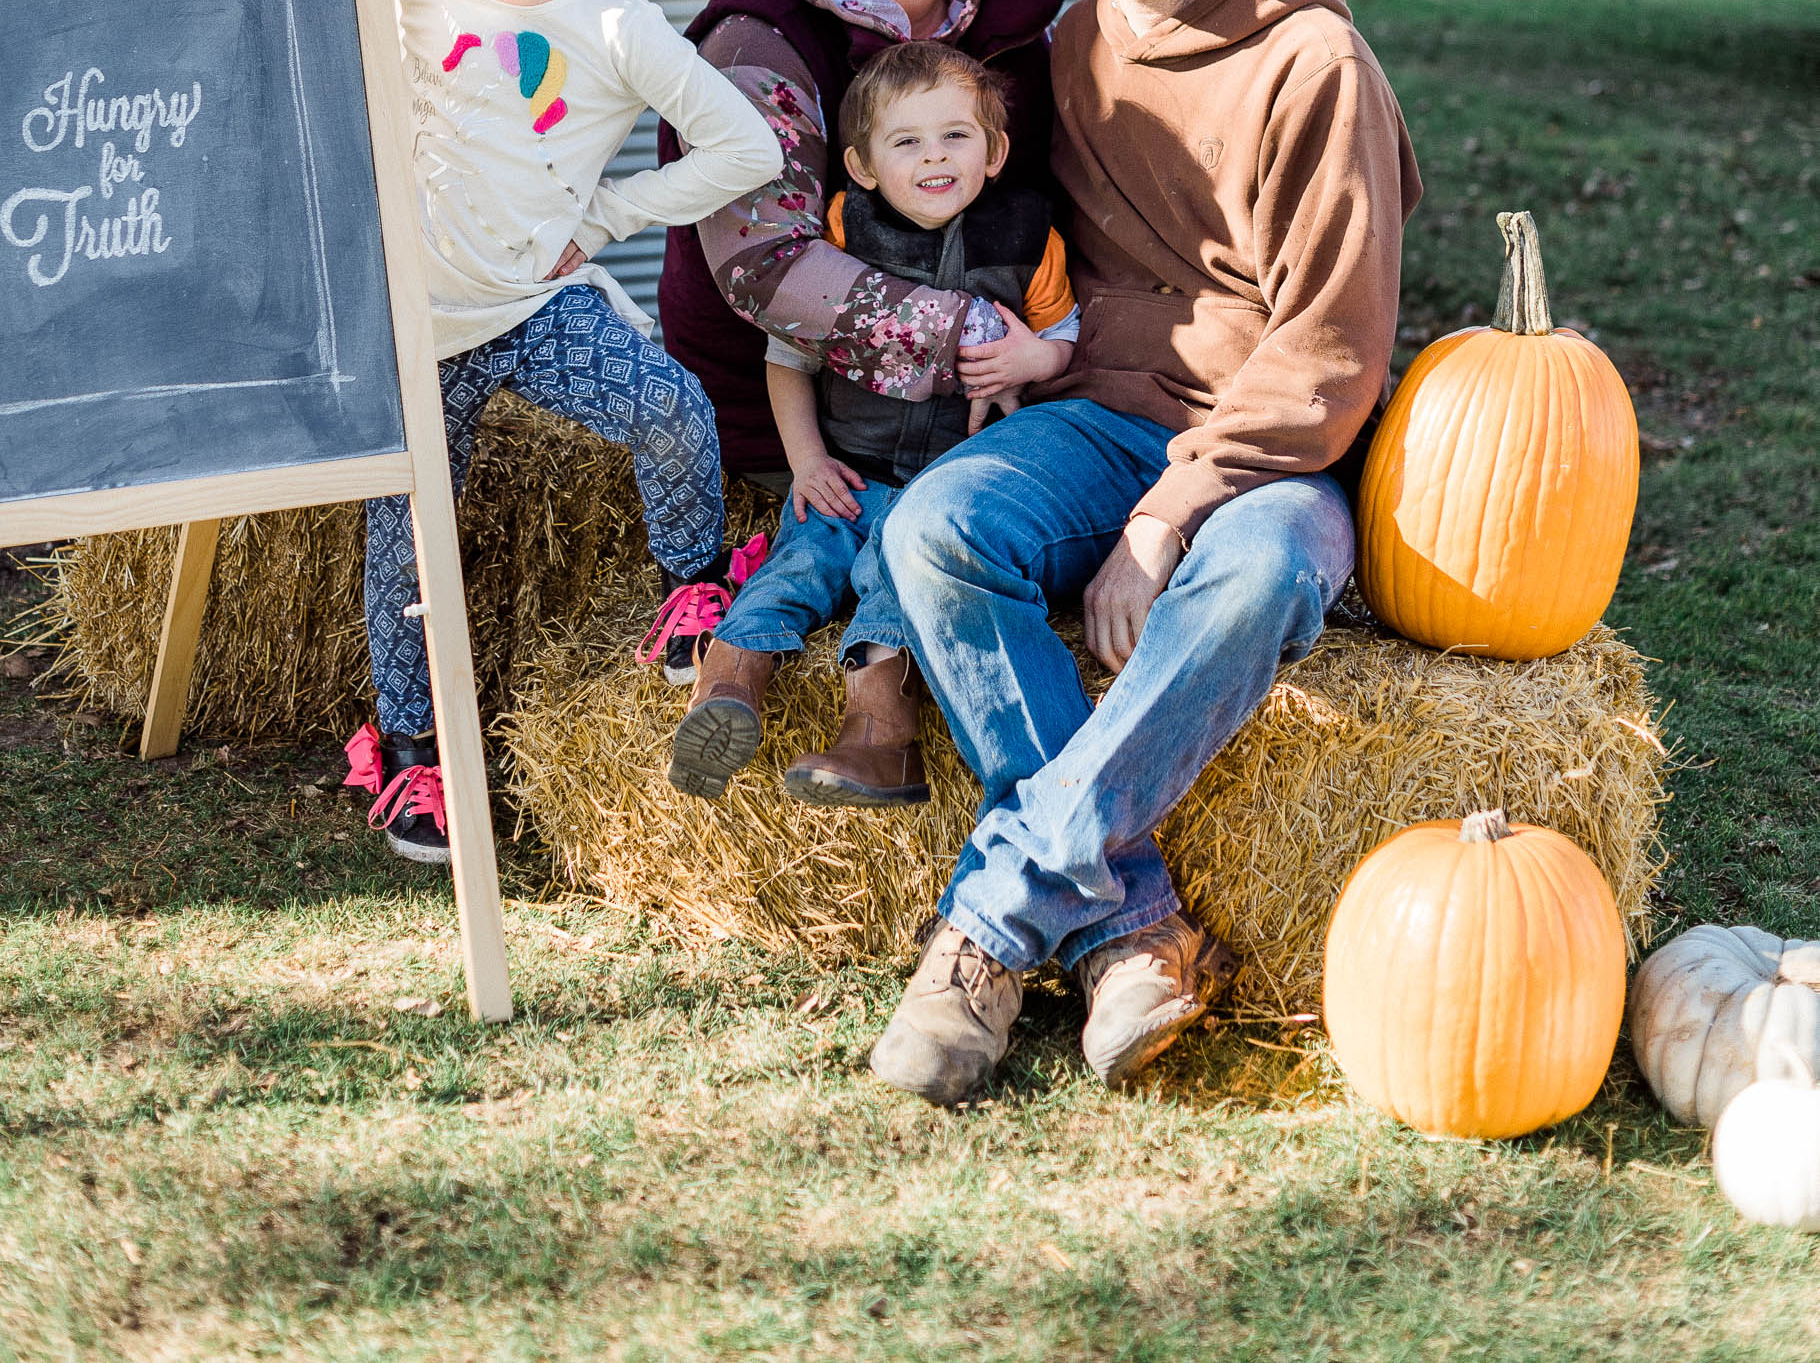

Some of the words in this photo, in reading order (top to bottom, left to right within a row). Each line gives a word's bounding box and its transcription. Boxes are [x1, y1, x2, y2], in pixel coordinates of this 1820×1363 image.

[22, 67, 201, 153] Hungry
[99, 141, 145, 199] for
[0, 185, 172, 287] Truth
